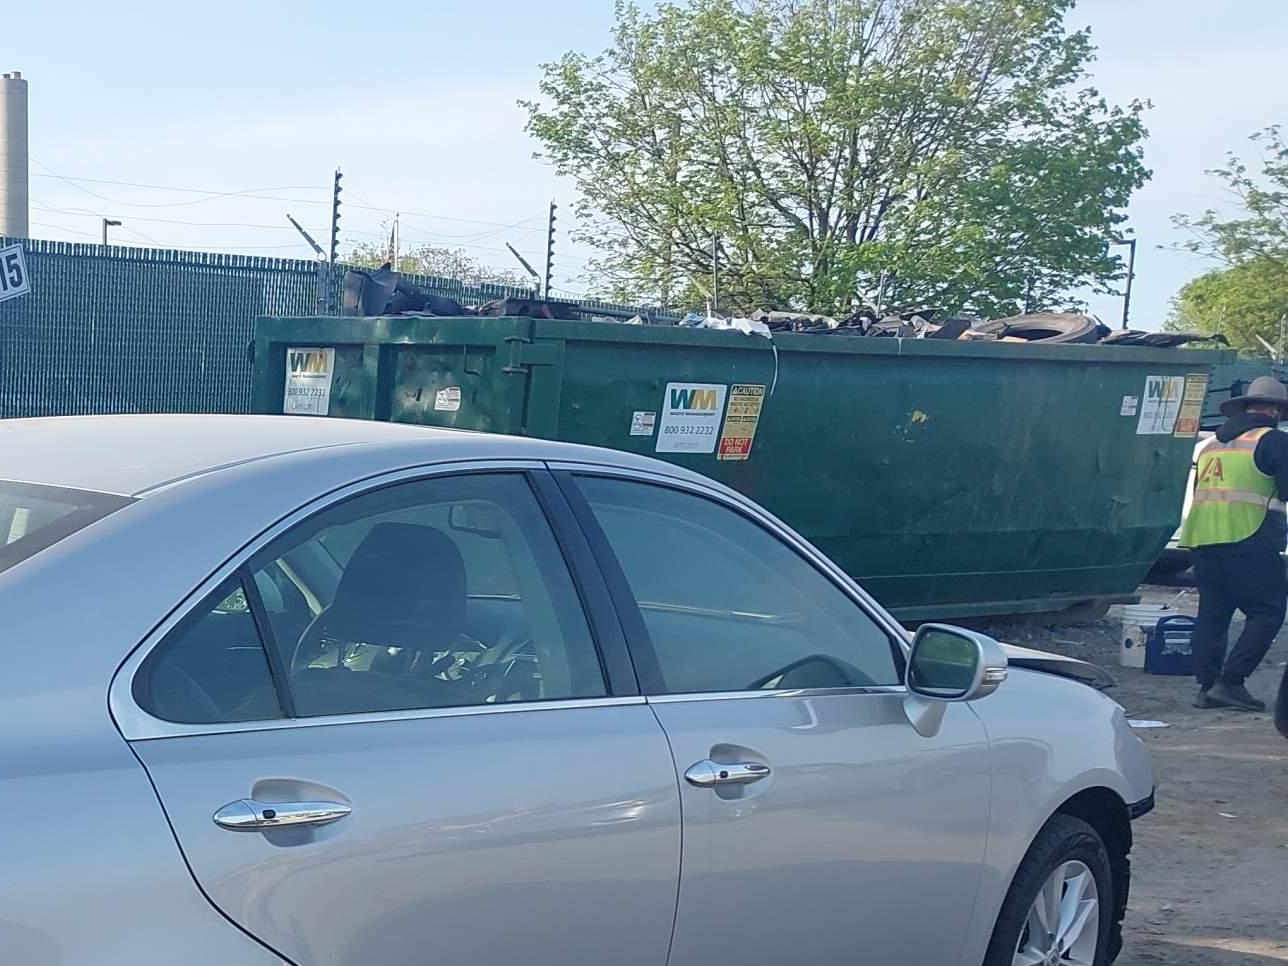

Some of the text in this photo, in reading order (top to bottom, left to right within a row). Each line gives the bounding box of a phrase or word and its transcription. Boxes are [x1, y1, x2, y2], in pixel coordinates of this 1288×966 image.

[289, 352, 328, 372] WM
[670, 388, 717, 410] WM
[724, 438, 749, 447] DO NOT
[725, 446, 744, 454] PARK
